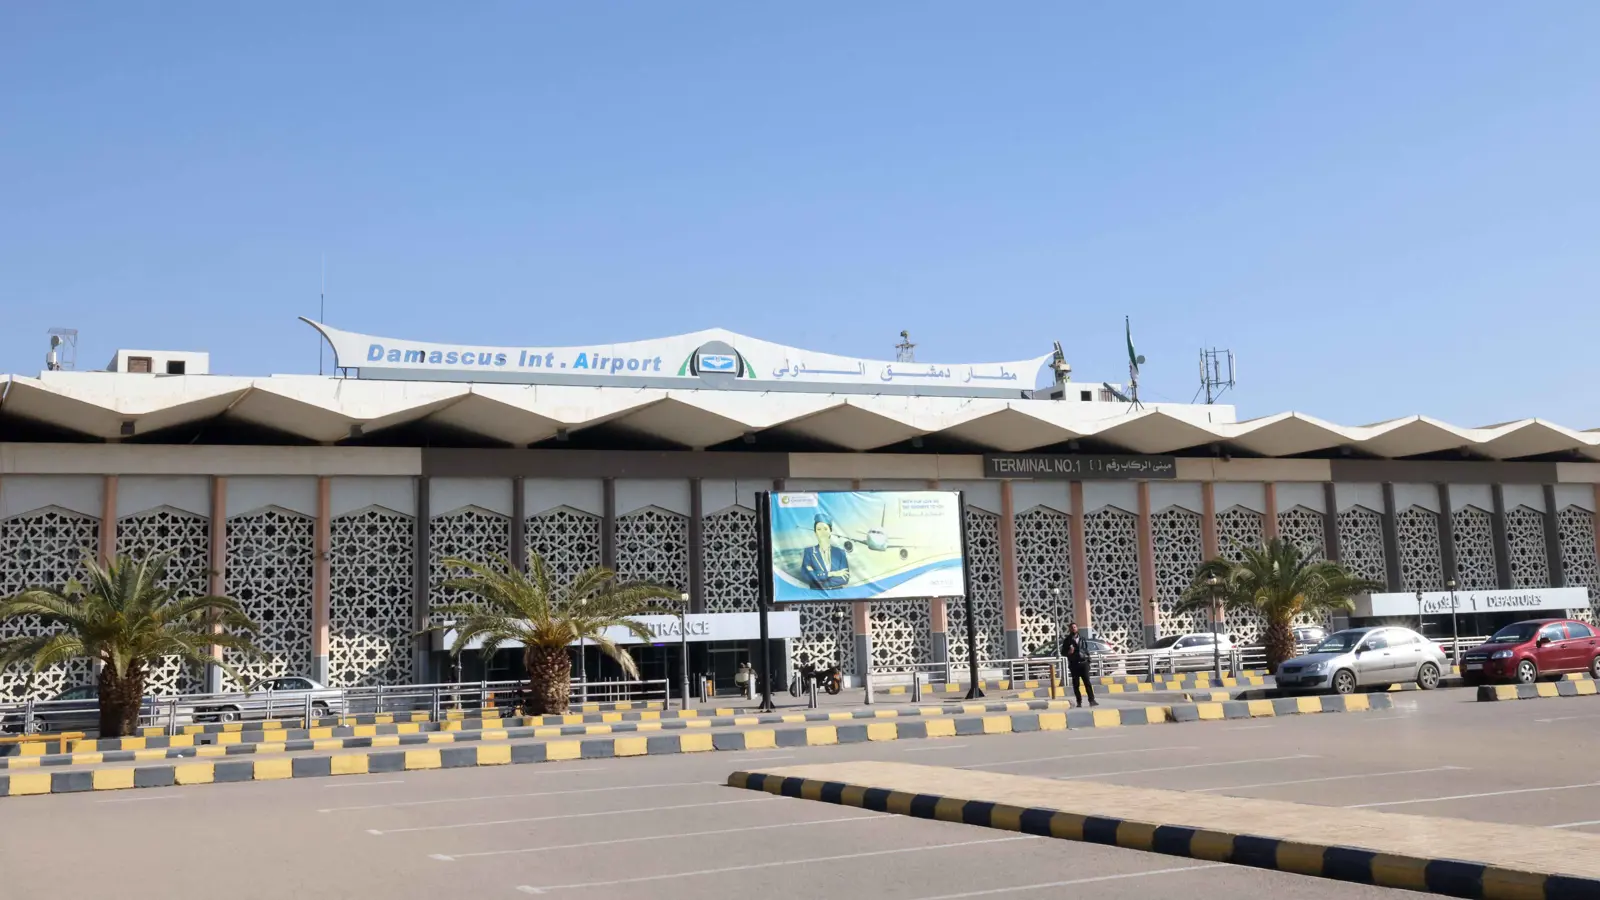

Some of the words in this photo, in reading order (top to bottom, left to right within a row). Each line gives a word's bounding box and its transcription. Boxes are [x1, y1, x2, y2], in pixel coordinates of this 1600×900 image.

[367, 343, 507, 366] Damascus
[573, 351, 662, 375] Airport
[772, 358, 866, 379] الدولي
[880, 362, 951, 382] دمشق
[962, 365, 1018, 382] مطار
[992, 458, 1052, 473] TERMINAL
[1054, 459, 1081, 473] NO.1
[1105, 458, 1120, 473] رقم
[1120, 460, 1151, 473] الركاب
